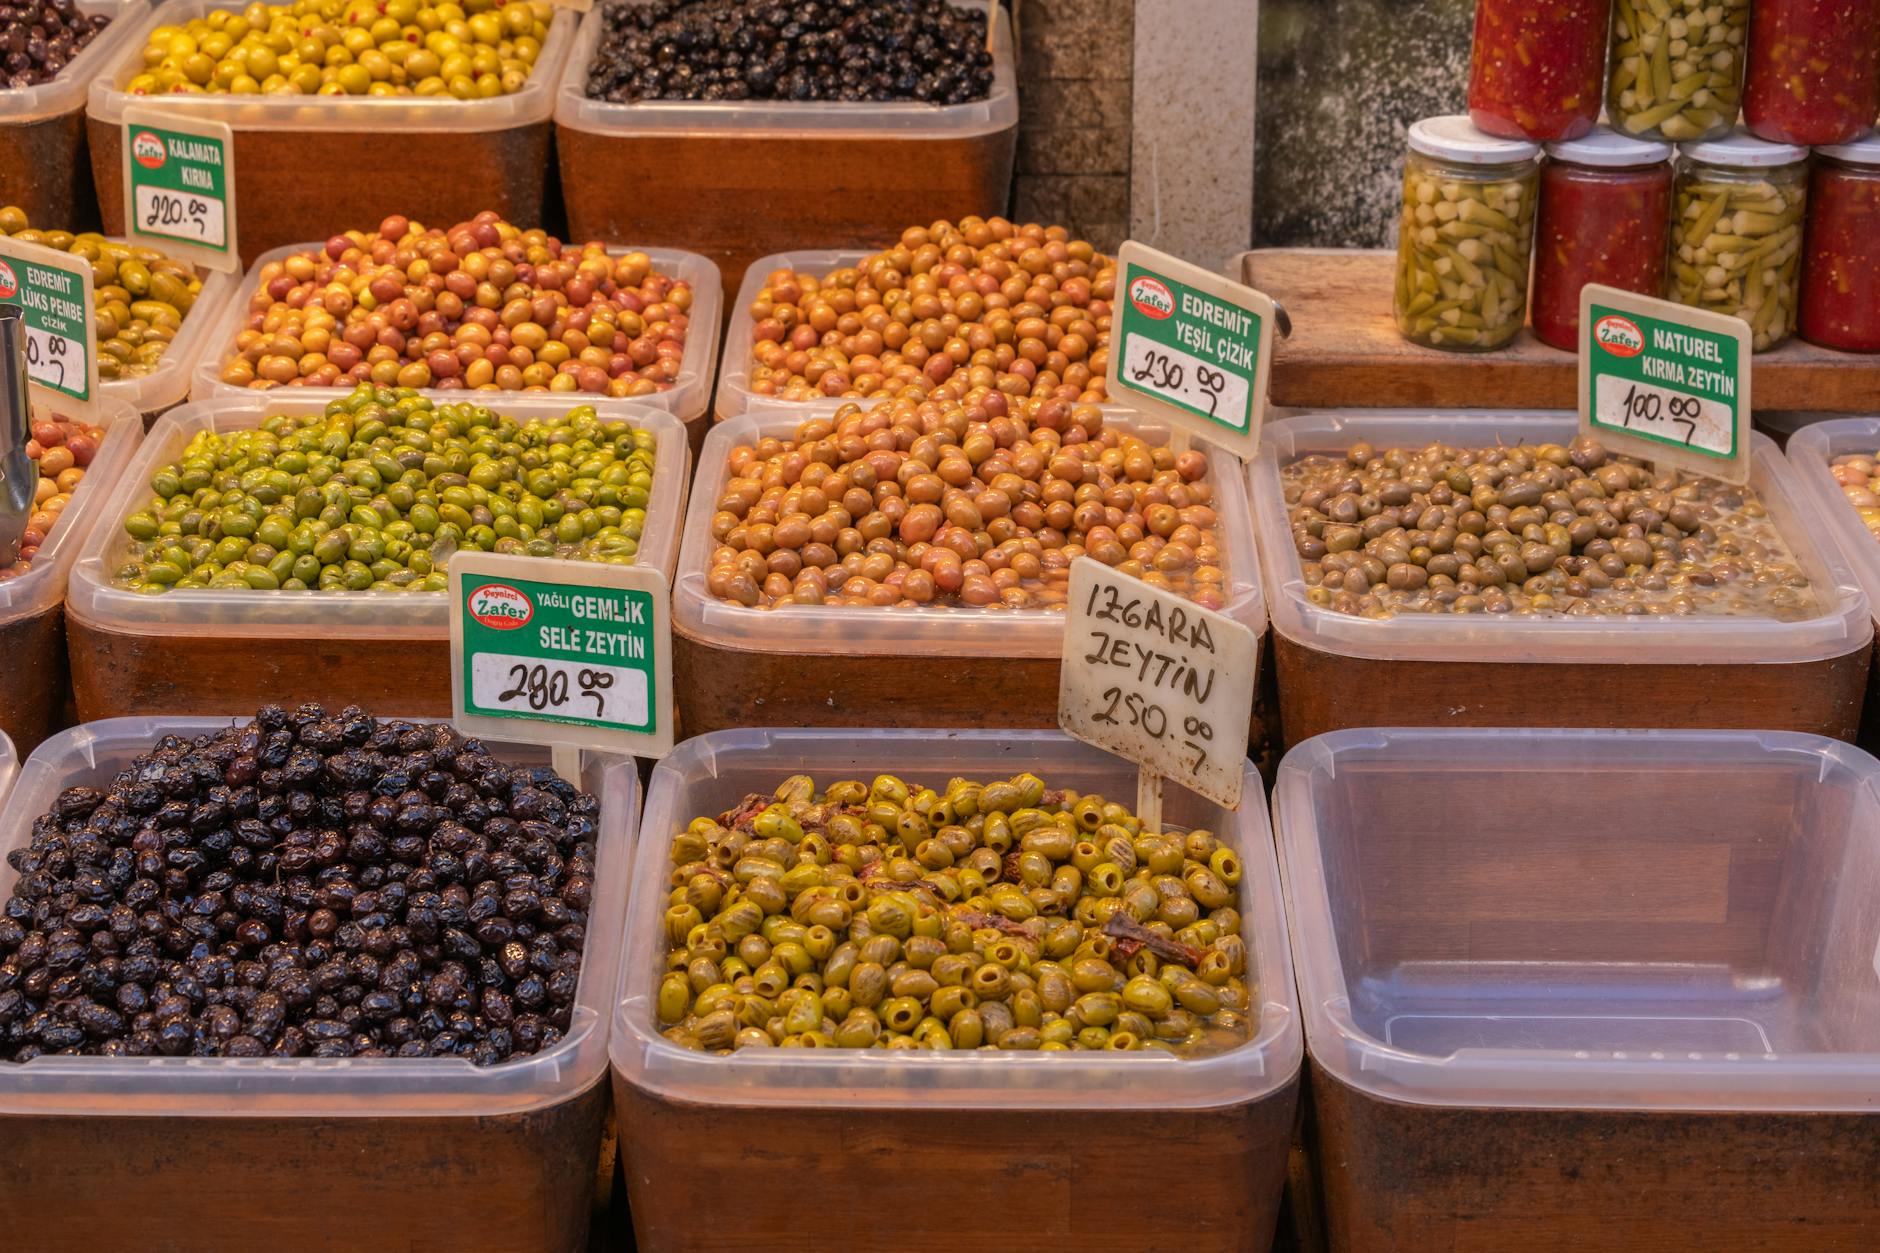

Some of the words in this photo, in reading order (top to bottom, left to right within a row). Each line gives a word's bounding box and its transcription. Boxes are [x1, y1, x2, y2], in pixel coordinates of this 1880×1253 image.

[168, 139, 221, 165] KALAMATA
[181, 166, 214, 190] KIRMA
[26, 267, 71, 294] EDREMİT
[20, 286, 48, 312] LÜKS
[50, 295, 83, 323] PEMBE
[1135, 288, 1171, 312] Zafer
[1182, 292, 1252, 337] EDREMİT
[41, 315, 67, 332] ÇİZİK
[1601, 328, 1639, 348] Zafer
[1175, 320, 1214, 354] YEŞİL
[1217, 336, 1254, 370] ÇİZİK
[1653, 328, 1723, 364] NATUREL
[1642, 355, 1685, 385] KIRMA
[1688, 367, 1735, 397] ZEYTİN
[477, 599, 527, 619] Zafer
[536, 591, 570, 609] YAĞLI
[571, 594, 645, 625] GEMLİK
[539, 626, 581, 651] SELE
[585, 629, 645, 660] ZEYTİN
[1085, 631, 1215, 704] ZEYTİN
